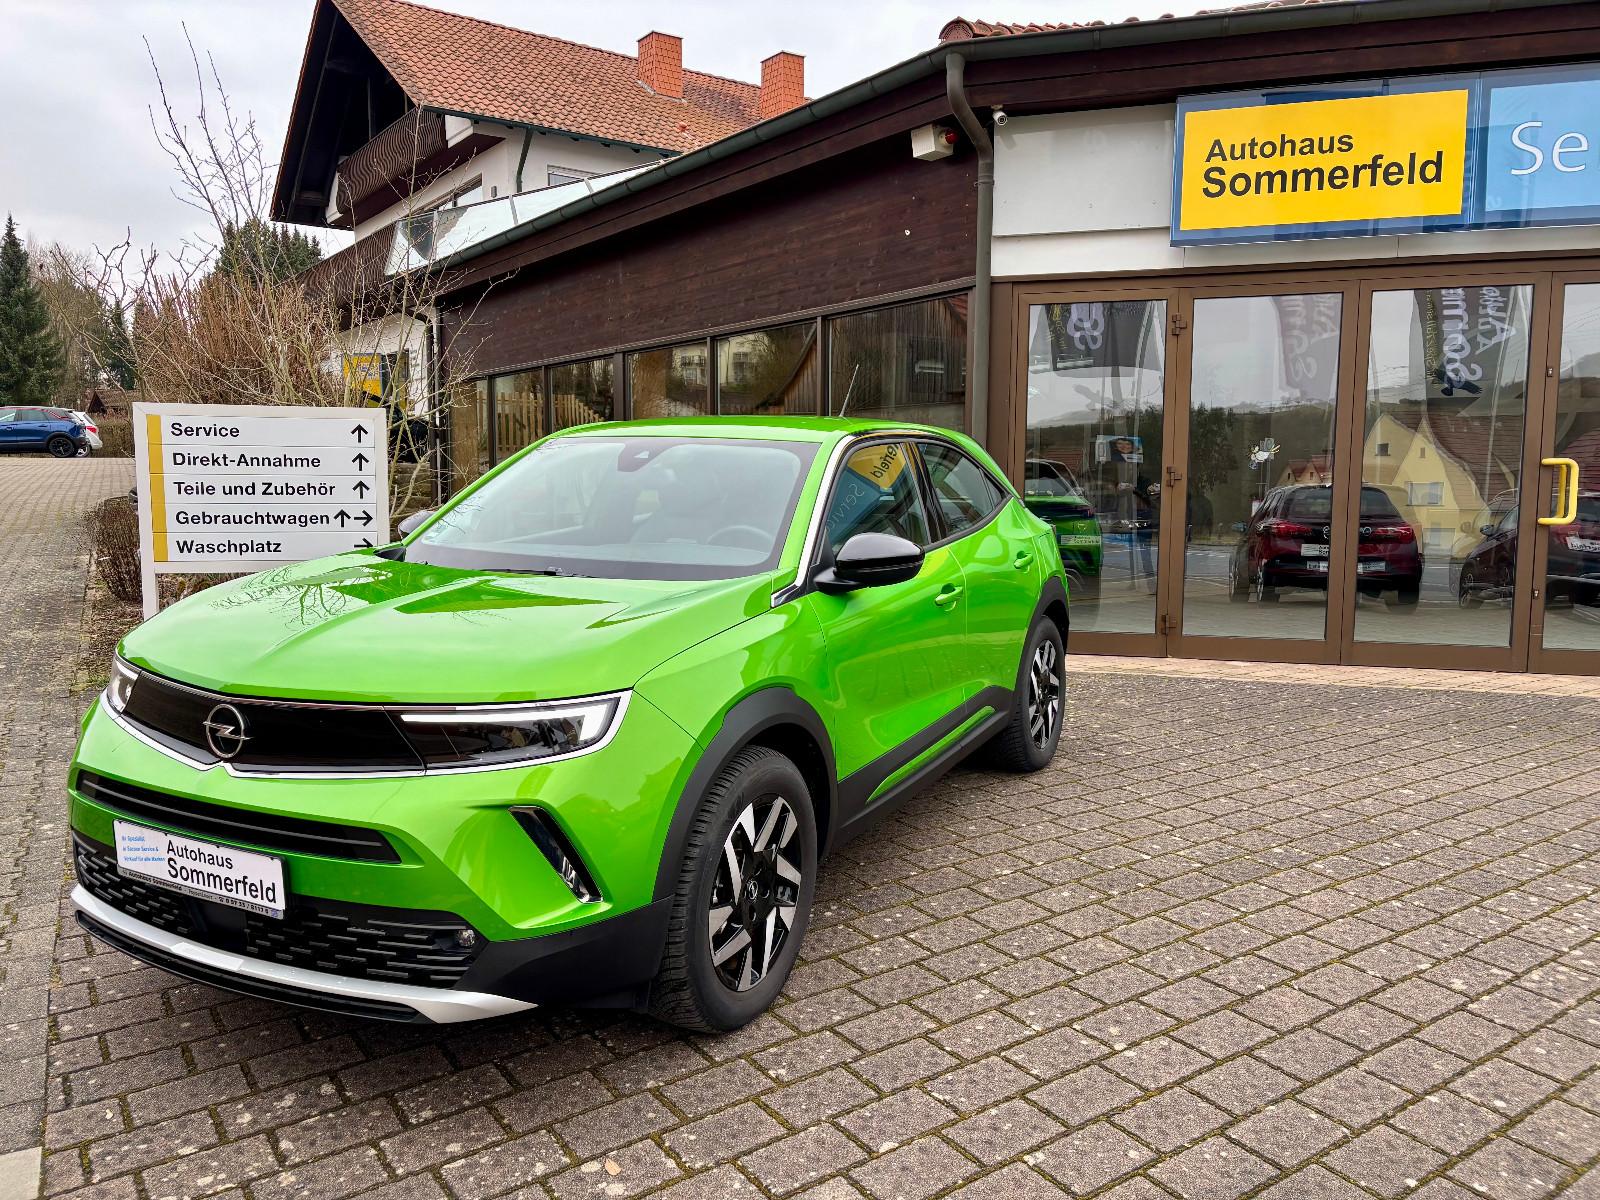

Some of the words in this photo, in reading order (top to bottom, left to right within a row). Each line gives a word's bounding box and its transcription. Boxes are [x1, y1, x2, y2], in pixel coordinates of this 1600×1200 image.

[1205, 133, 1354, 163] Autohaus
[1510, 120, 1589, 175] Se
[1201, 150, 1444, 198] Sommerfeld
[170, 422, 240, 437] Service
[172, 452, 321, 468] Direkt-Annahme
[173, 481, 216, 496] Teile
[222, 482, 256, 496] und
[262, 481, 336, 497] Zubehör
[175, 510, 330, 528] Gebrauchtwagen
[176, 539, 282, 556] Waschplatz
[166, 839, 233, 870] Autohaus
[167, 857, 277, 904] Sommerfeld
